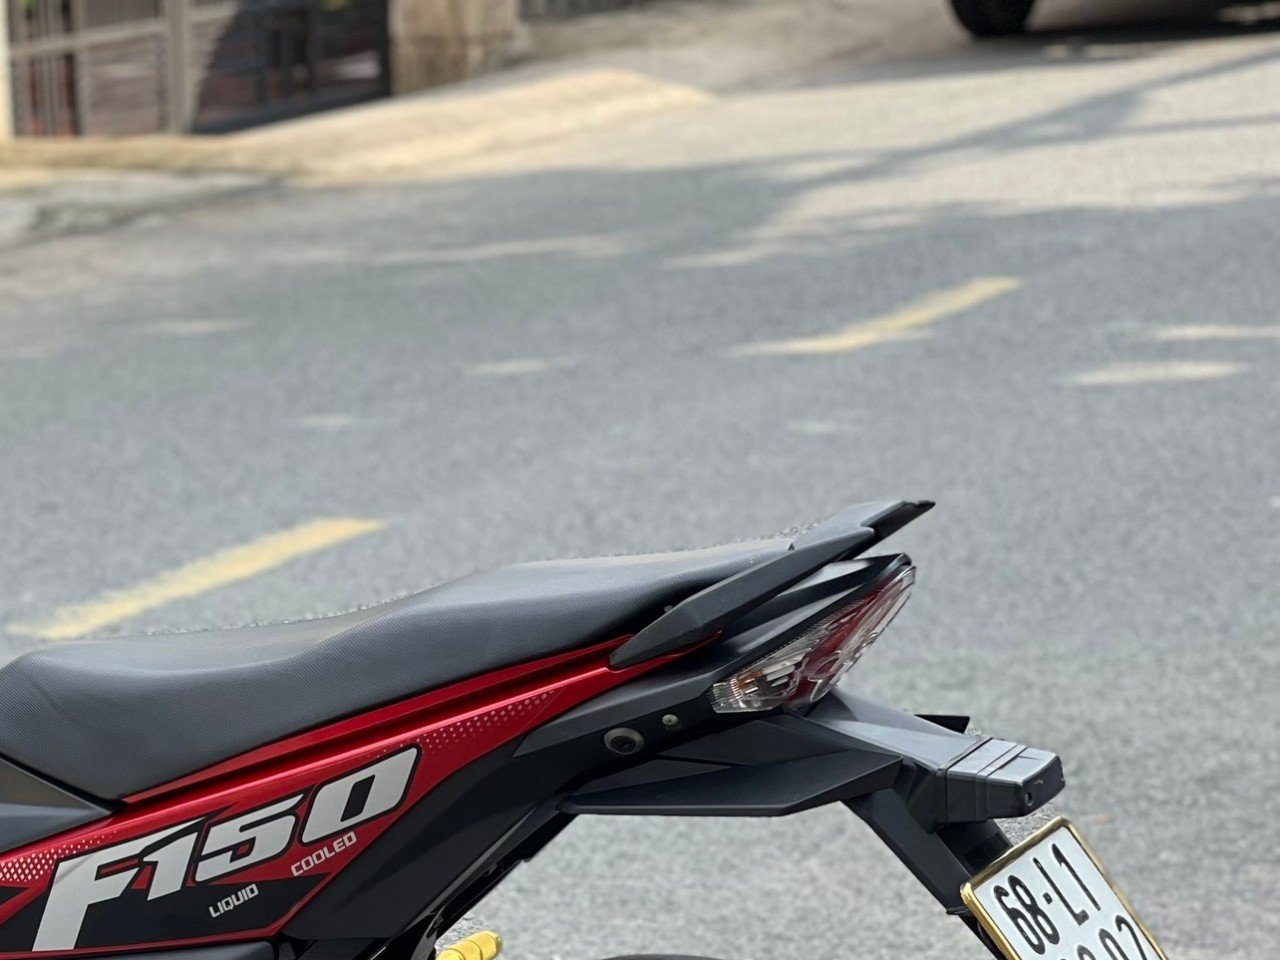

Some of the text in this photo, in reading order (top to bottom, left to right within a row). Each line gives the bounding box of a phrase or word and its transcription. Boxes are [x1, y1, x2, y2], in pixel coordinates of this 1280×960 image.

[32, 747, 418, 952] F150
[291, 831, 357, 877] COOLED
[209, 883, 259, 918] LIQUID
[993, 843, 1101, 955] 68-L1
